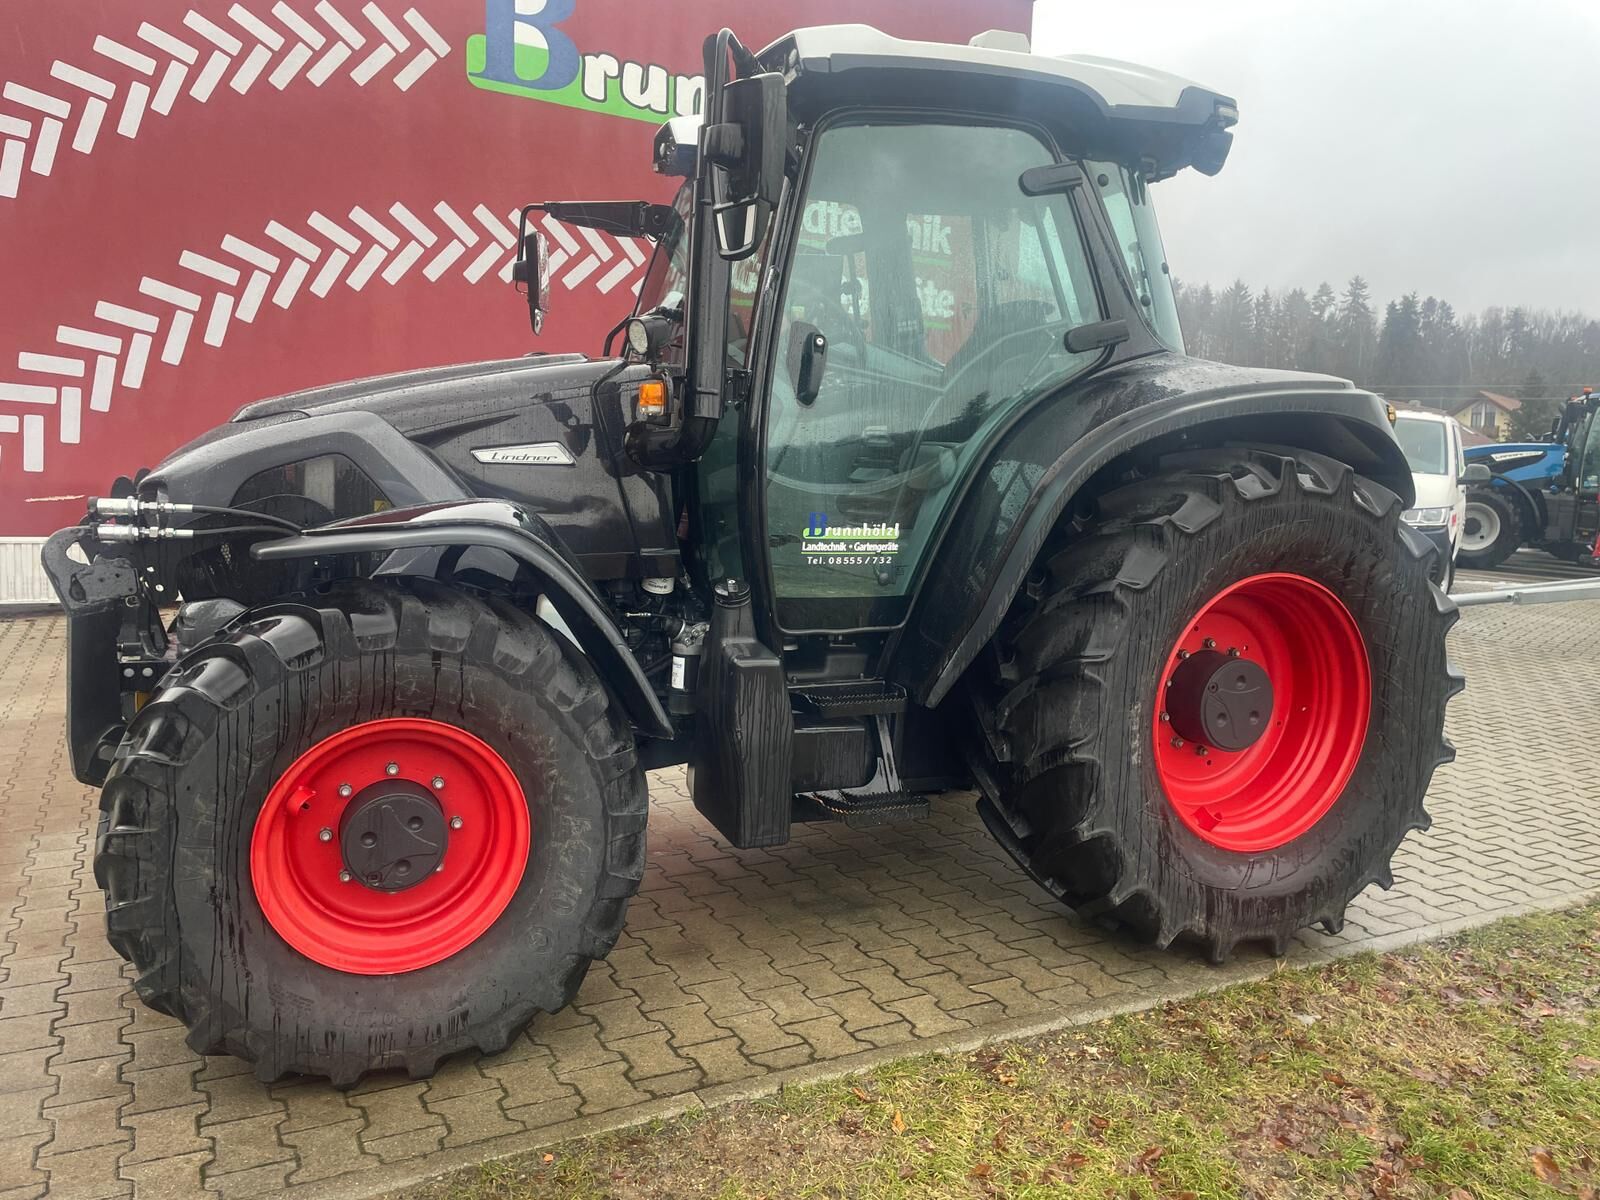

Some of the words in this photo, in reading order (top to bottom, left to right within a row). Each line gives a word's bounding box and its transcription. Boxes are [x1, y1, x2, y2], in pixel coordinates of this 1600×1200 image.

[468, 0, 706, 117] Brun
[492, 452, 558, 461] Lindner
[806, 511, 900, 538] Brunnhölzl
[801, 541, 847, 552] Landtechnik
[853, 541, 899, 553] Gartengeräte
[806, 556, 826, 565] Tel.
[828, 556, 892, 565] 08555/732
